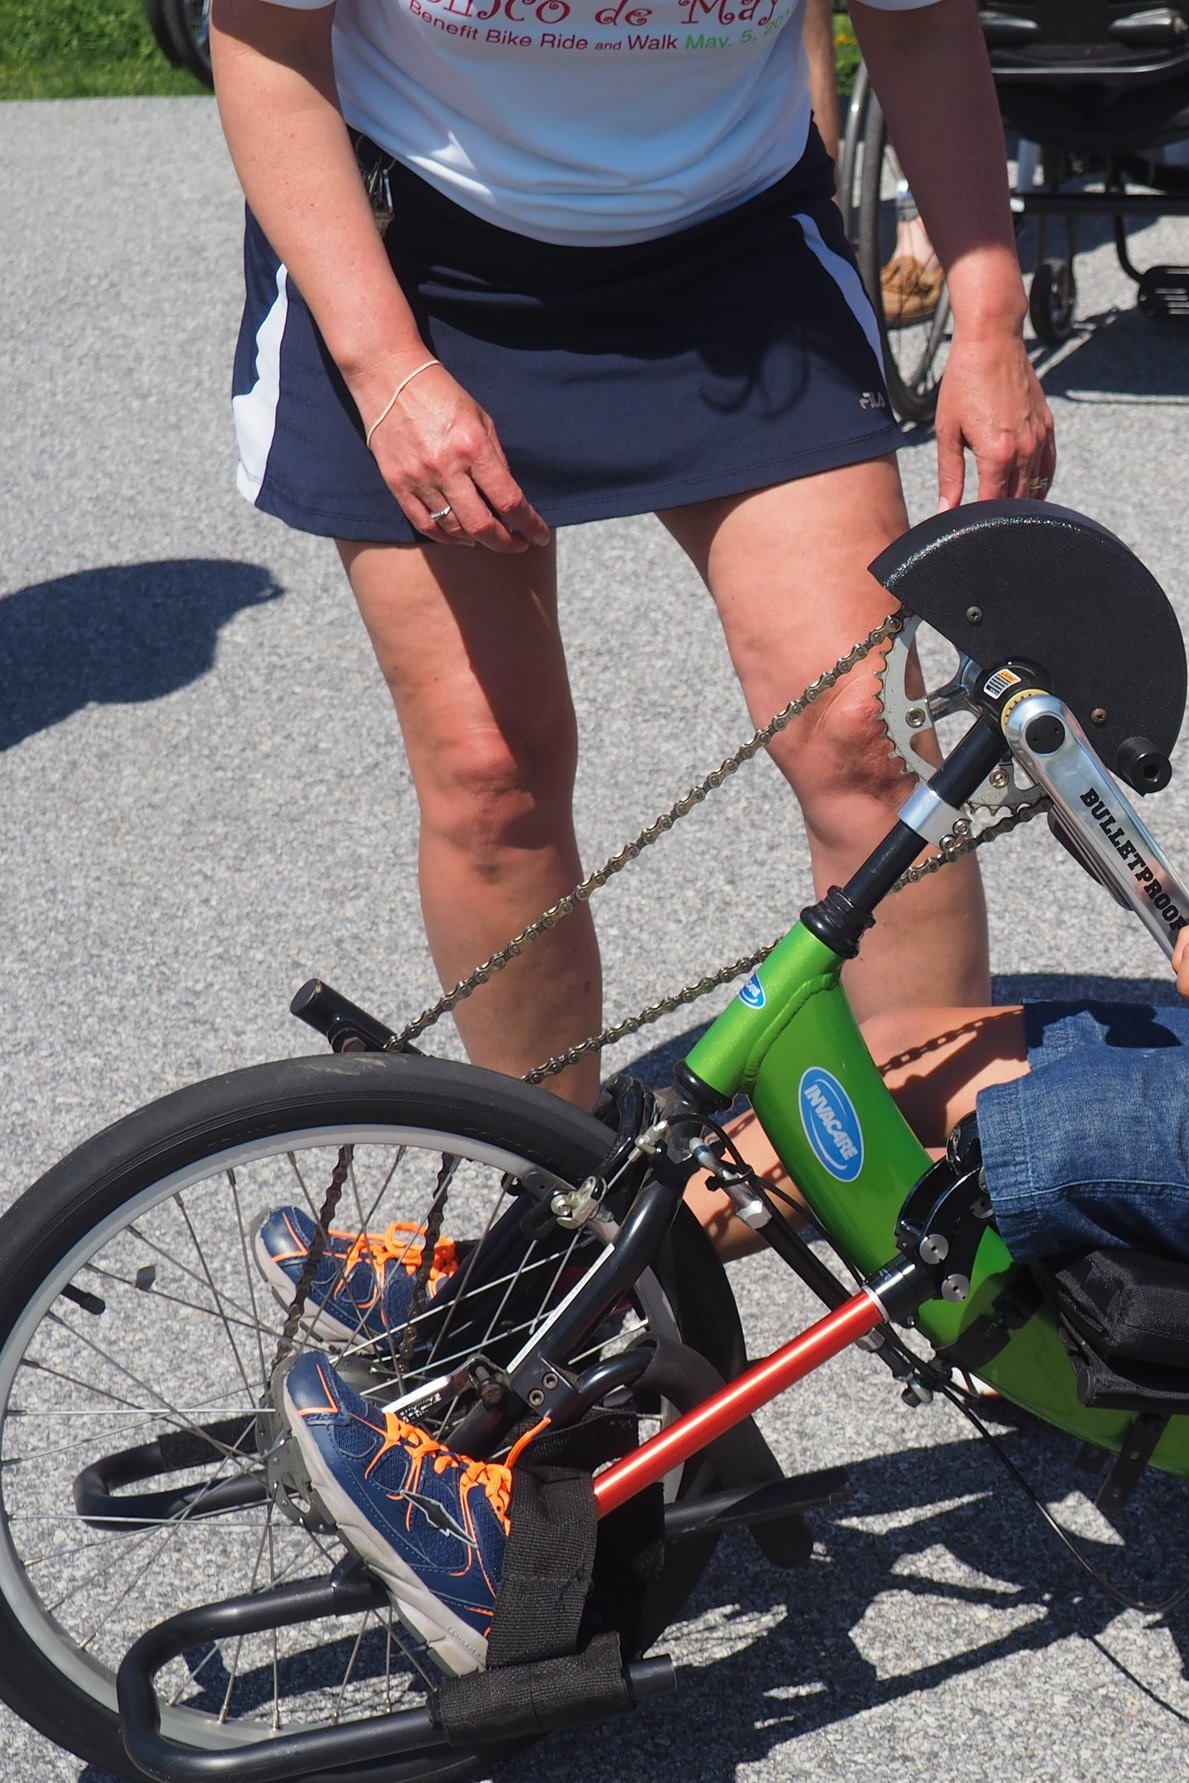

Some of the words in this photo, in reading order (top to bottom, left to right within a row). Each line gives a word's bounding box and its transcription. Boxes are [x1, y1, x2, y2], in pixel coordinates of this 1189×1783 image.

[409, 1, 479, 41] Benefit
[485, 29, 533, 47] Bike
[540, 32, 589, 51] Ride
[594, 40, 622, 51] and
[627, 34, 679, 51] Walk
[594, 0, 653, 26] de
[803, 1084, 859, 1161] INVACARE
